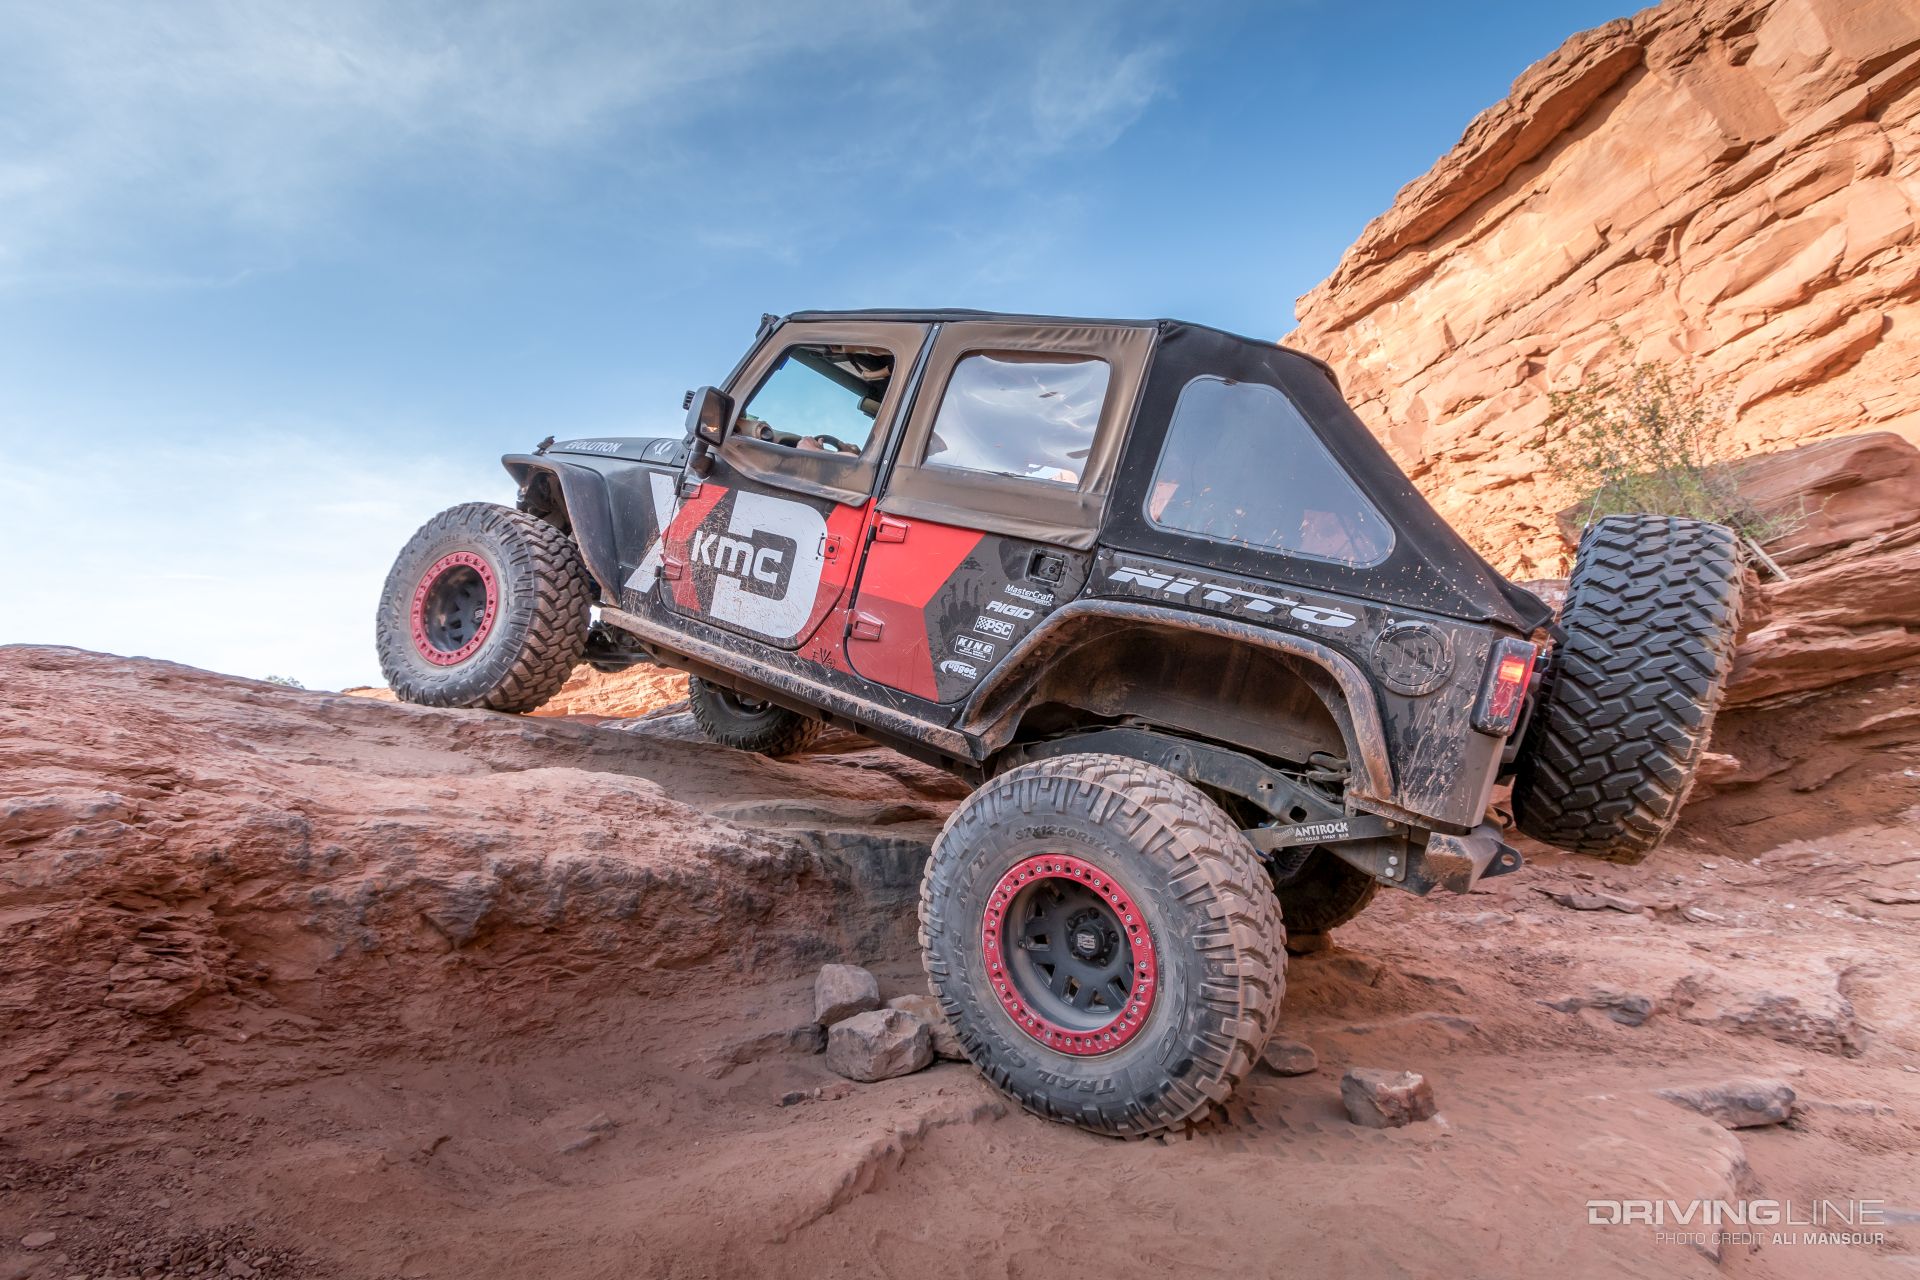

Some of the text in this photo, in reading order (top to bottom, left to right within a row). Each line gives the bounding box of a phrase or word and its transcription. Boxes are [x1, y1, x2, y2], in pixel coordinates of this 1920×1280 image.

[564, 441, 623, 453] EVOLUTION
[1004, 583, 1054, 602] MasterCraft
[1108, 567, 1357, 628] NITTO
[985, 600, 1035, 620] RIGID
[985, 618, 1013, 636] PSC
[957, 637, 993, 653] KING
[1295, 822, 1348, 837] ANTIROCK
[1037, 1068, 1117, 1096] TRAIL
